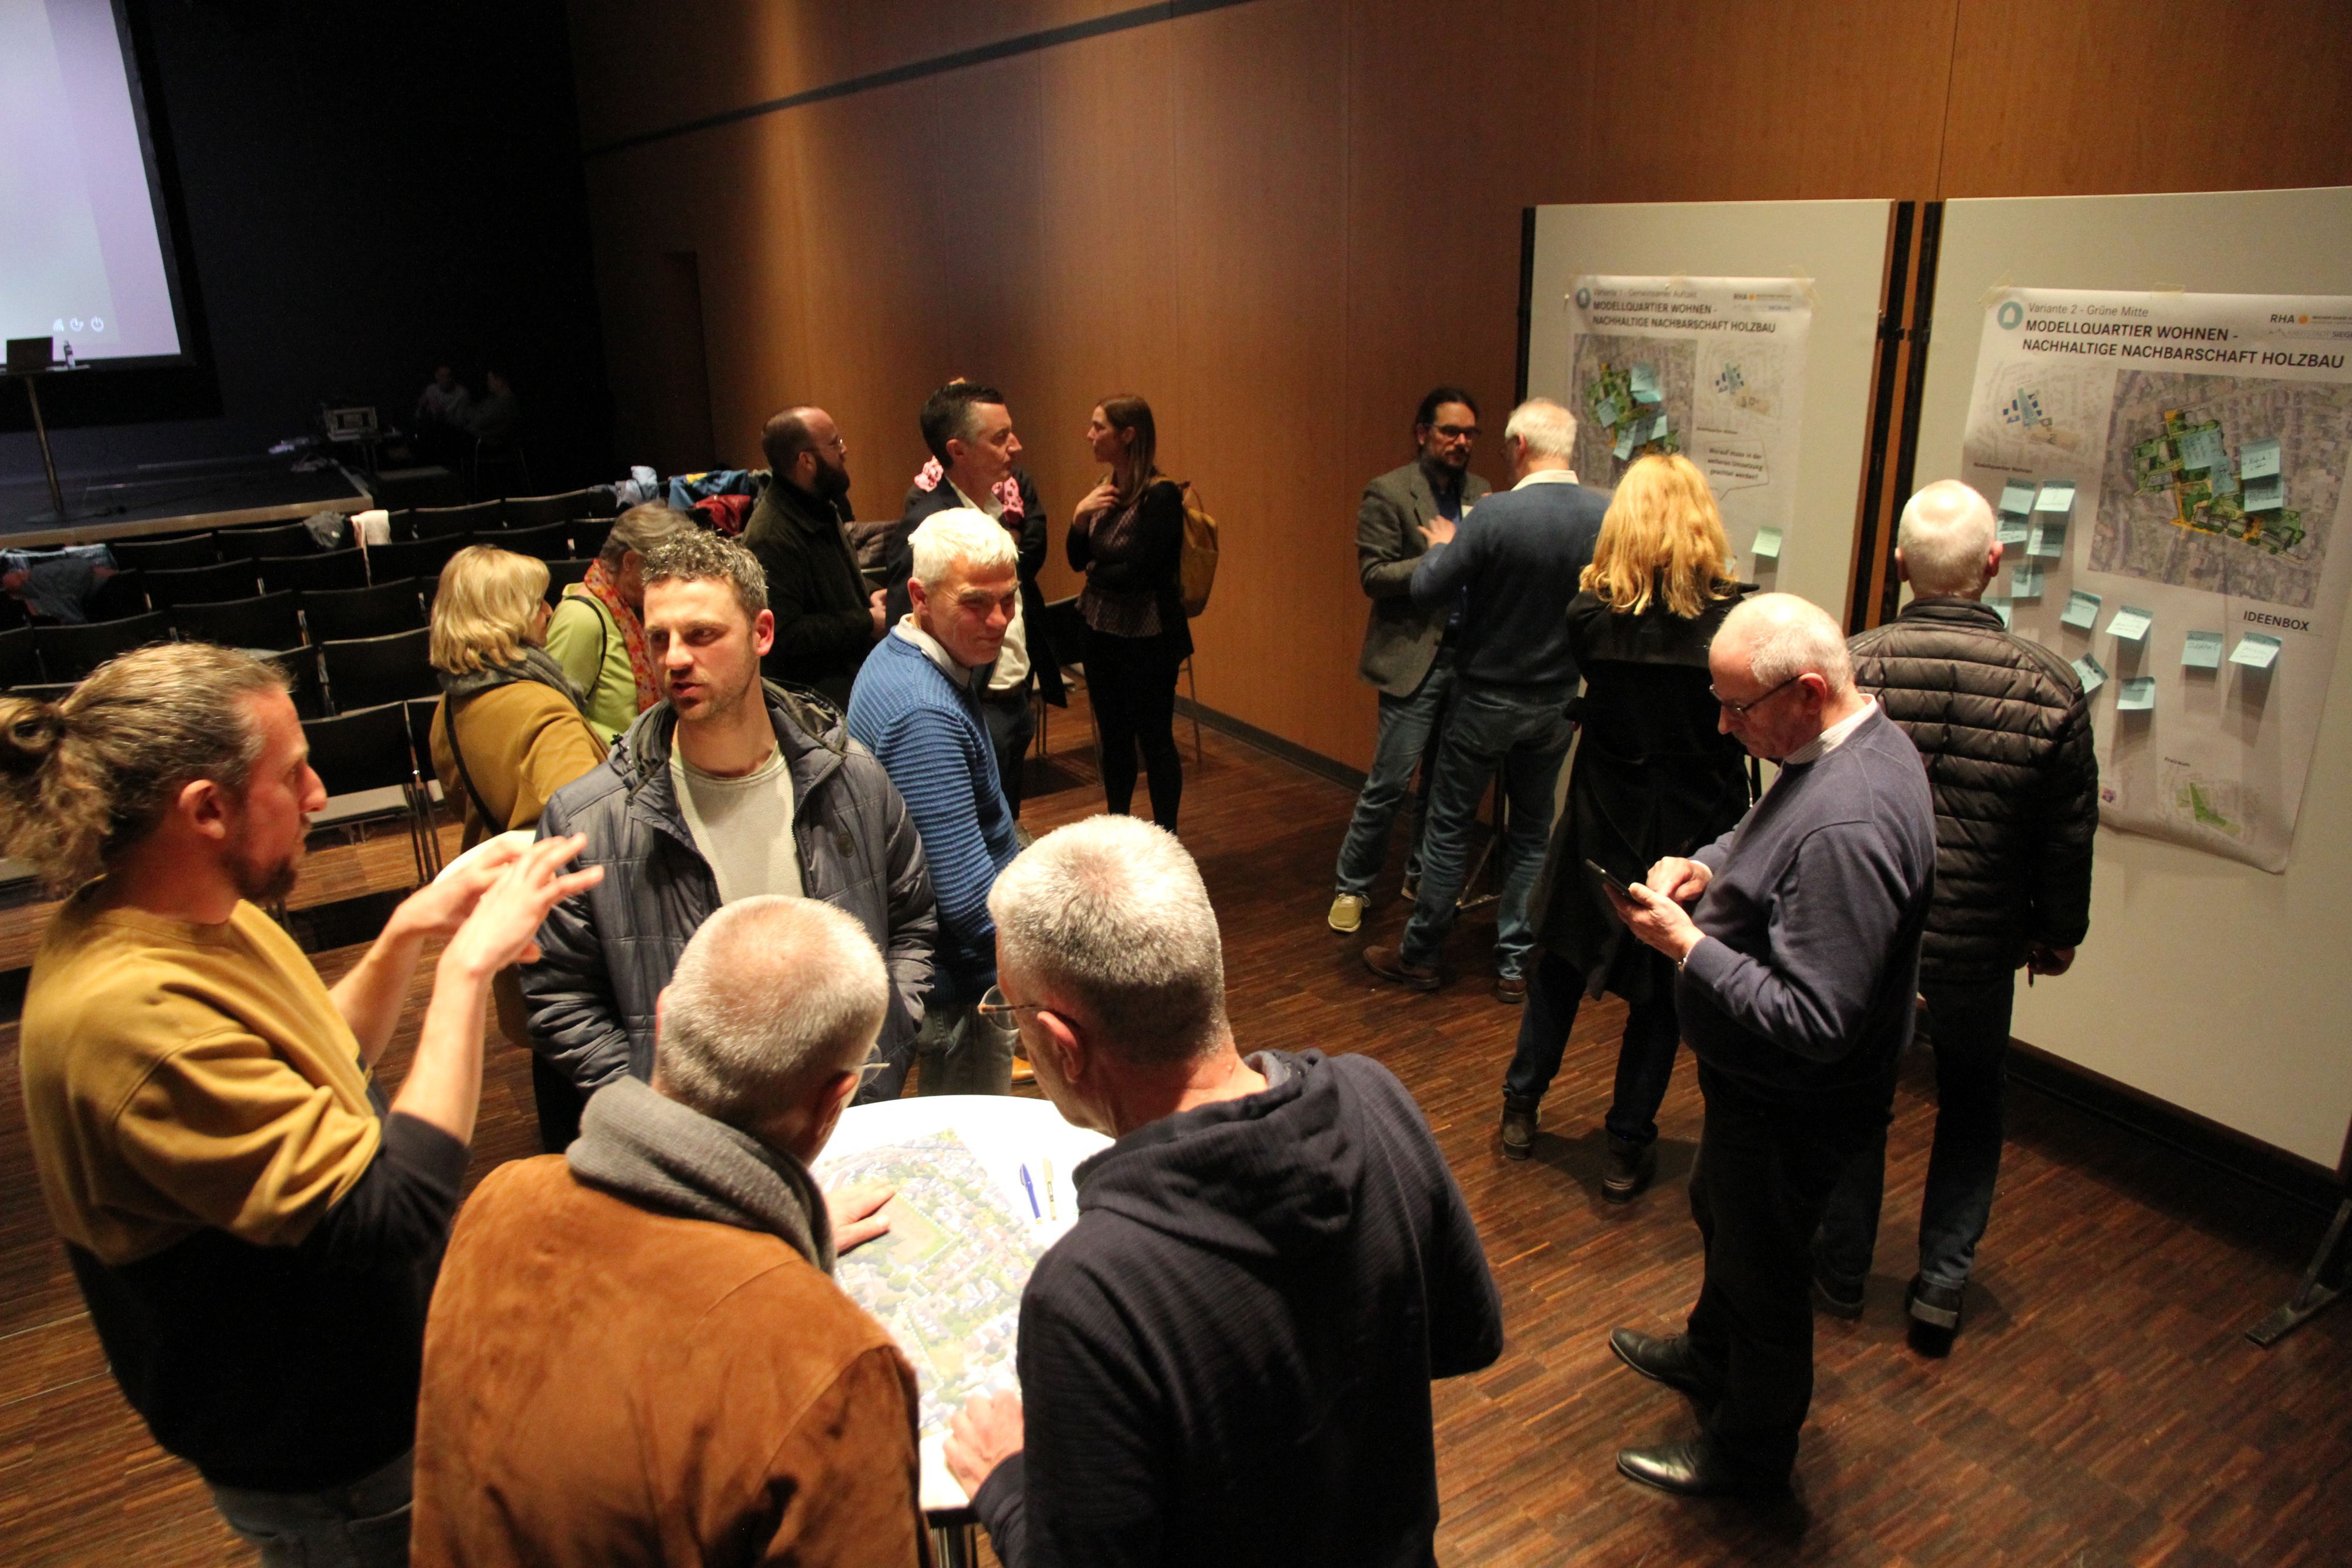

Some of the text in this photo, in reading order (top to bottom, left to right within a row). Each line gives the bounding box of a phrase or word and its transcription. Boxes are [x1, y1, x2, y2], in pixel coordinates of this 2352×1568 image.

[1593, 301, 1668, 312] MODELLQUARTIER
[1671, 303, 1712, 314] WOHNEN
[2029, 302, 2068, 315] Variante
[2071, 304, 2078, 315] 2
[2087, 305, 2117, 316] Grüne
[2121, 306, 2149, 317] Mitte
[1593, 316, 1776, 333] NACHHALTIGE NACHBARSCHAFT HOLZBAU
[2270, 314, 2294, 323] RHA
[2026, 319, 2153, 338] MODELLQUARTIER
[2157, 326, 2229, 341] WOHNEN
[2022, 339, 2344, 369] NACHHALTIGE NACHBARSCHAFT HOLZBAU
[2243, 611, 2310, 632] IDEENBOX
